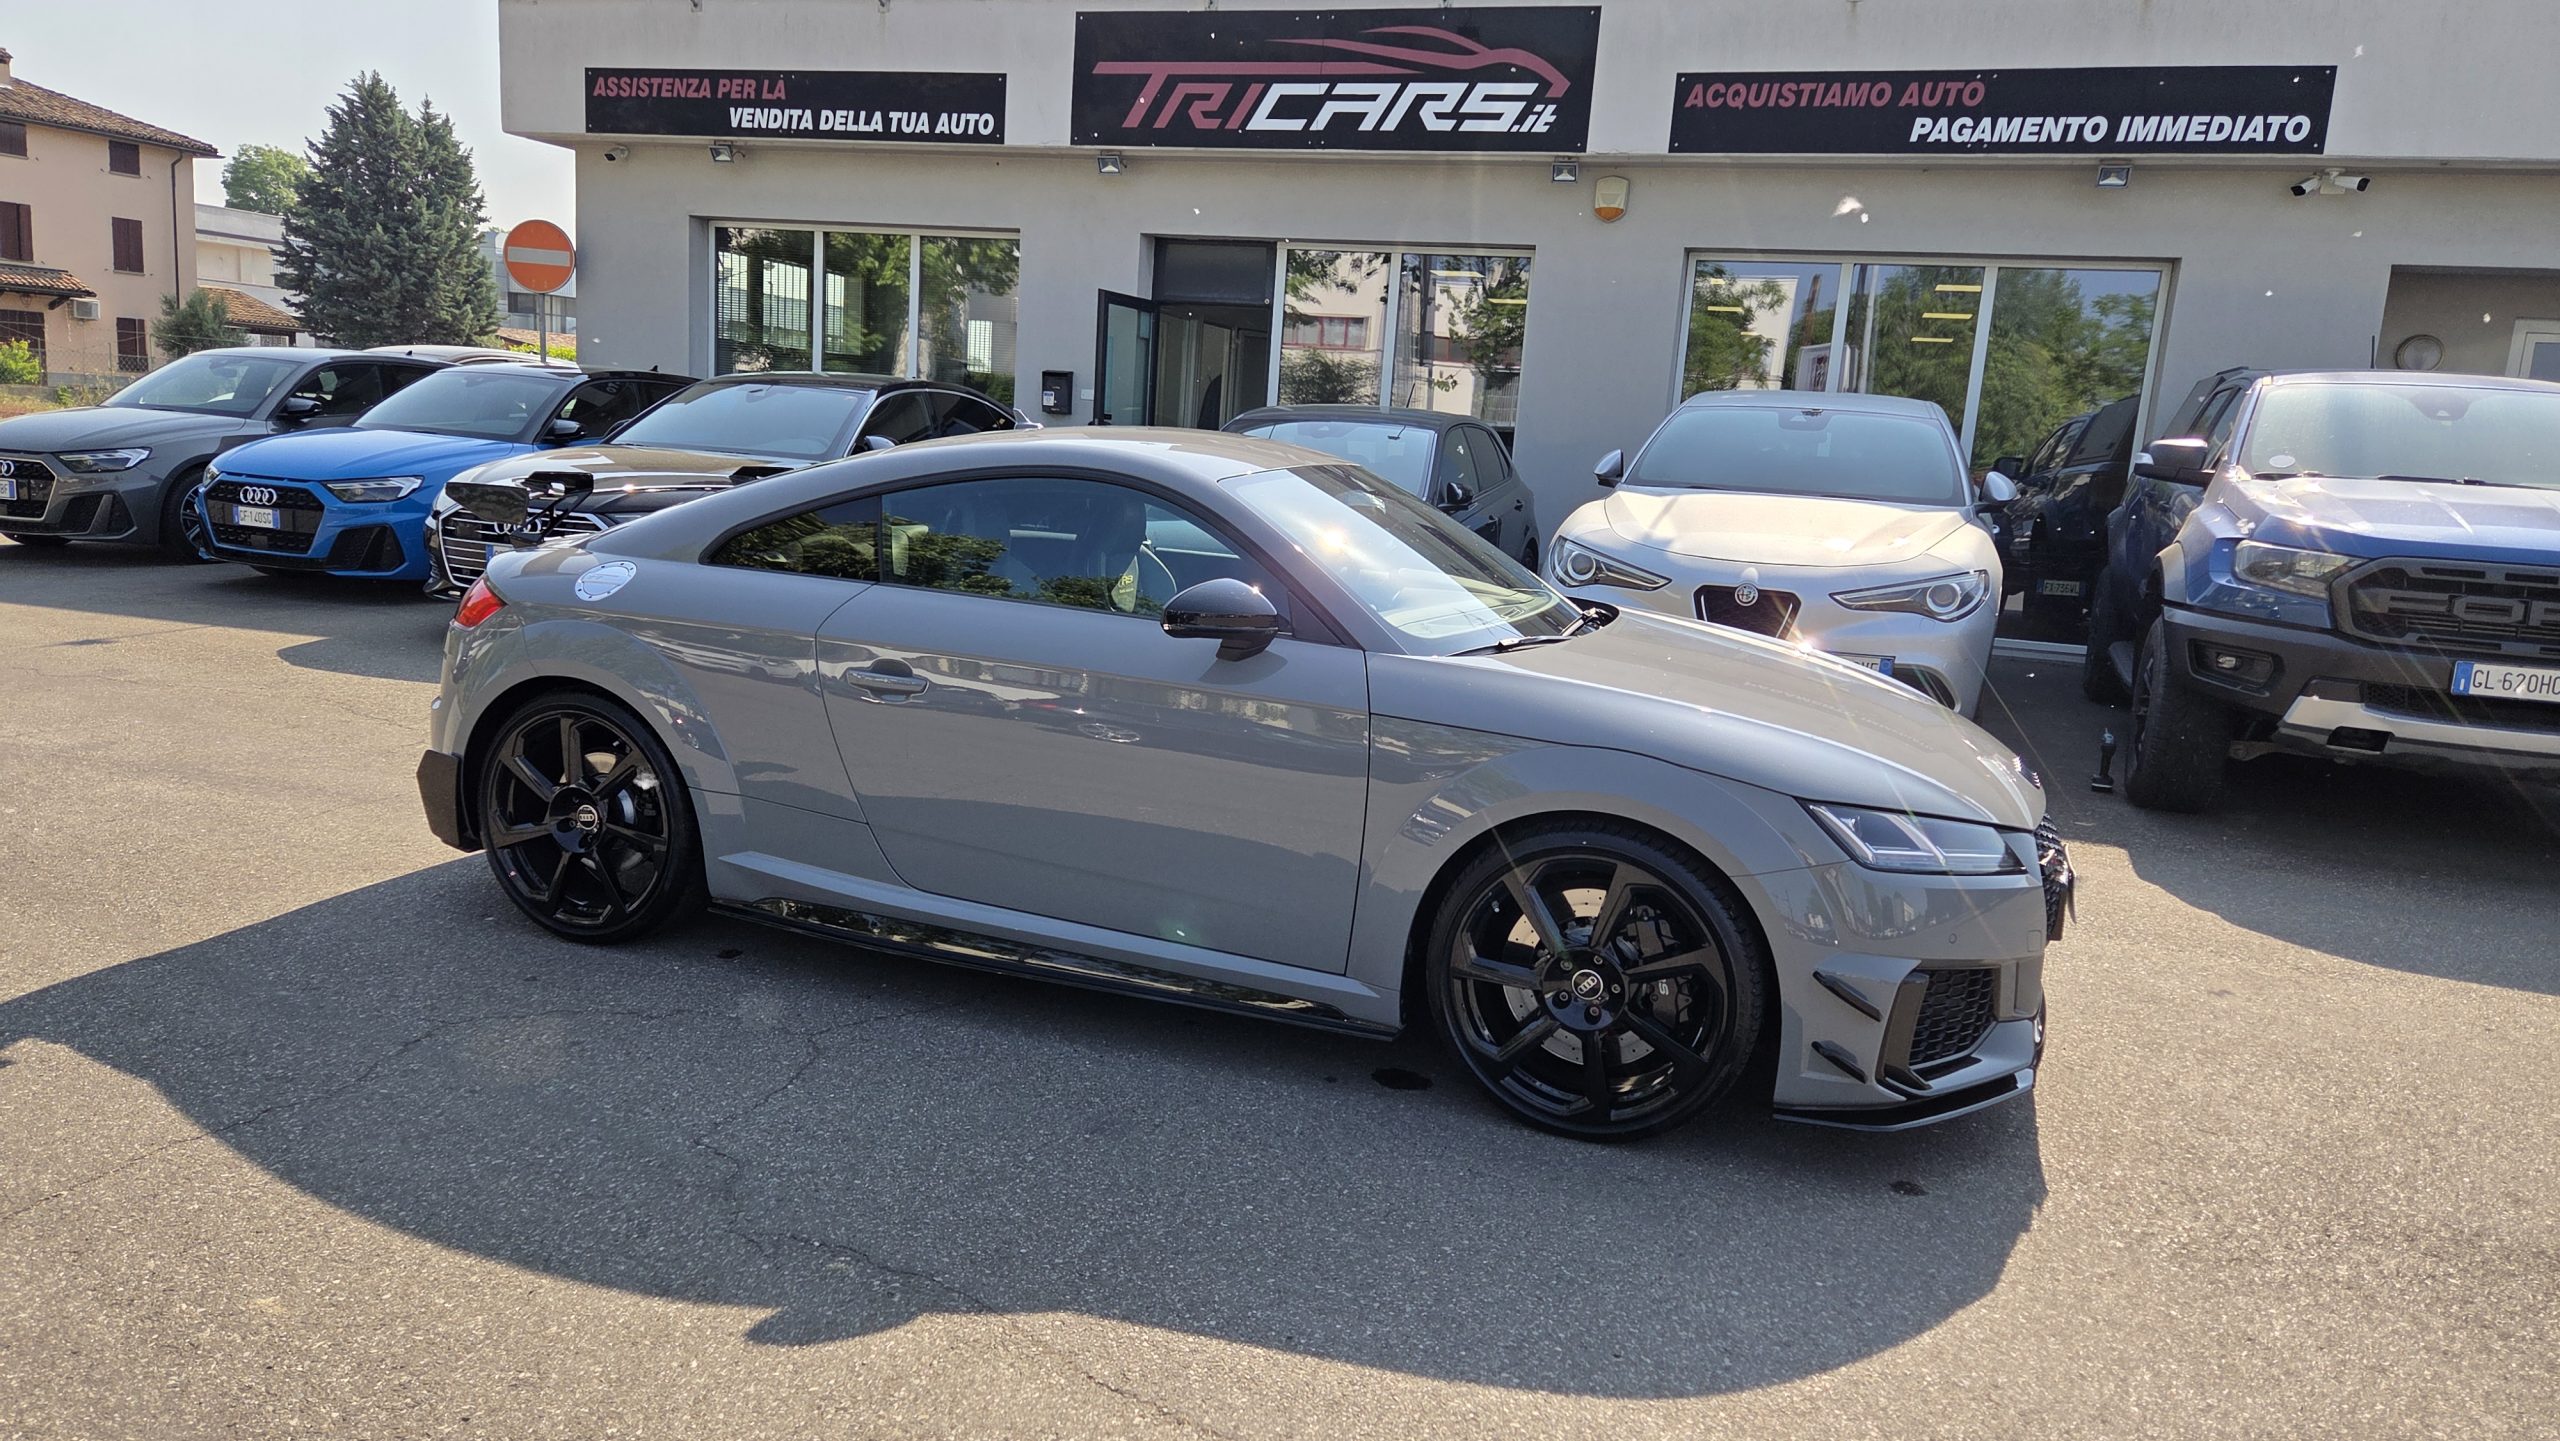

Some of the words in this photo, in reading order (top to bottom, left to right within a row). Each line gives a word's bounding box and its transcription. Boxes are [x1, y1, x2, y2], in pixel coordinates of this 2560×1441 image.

[593, 76, 712, 99] ASSISTENZA
[717, 79, 757, 100] PER
[762, 79, 786, 100] LA
[1684, 82, 1893, 110] ACQUISTIAMO
[1898, 81, 1986, 108] AUTO
[729, 107, 813, 130] VENDITA
[819, 109, 884, 133] DELLA
[888, 111, 930, 134] TUA
[934, 113, 995, 136] AUTO
[1909, 116, 2109, 143] PAGAMENTO
[2115, 115, 2312, 143] IMMEDIATO
